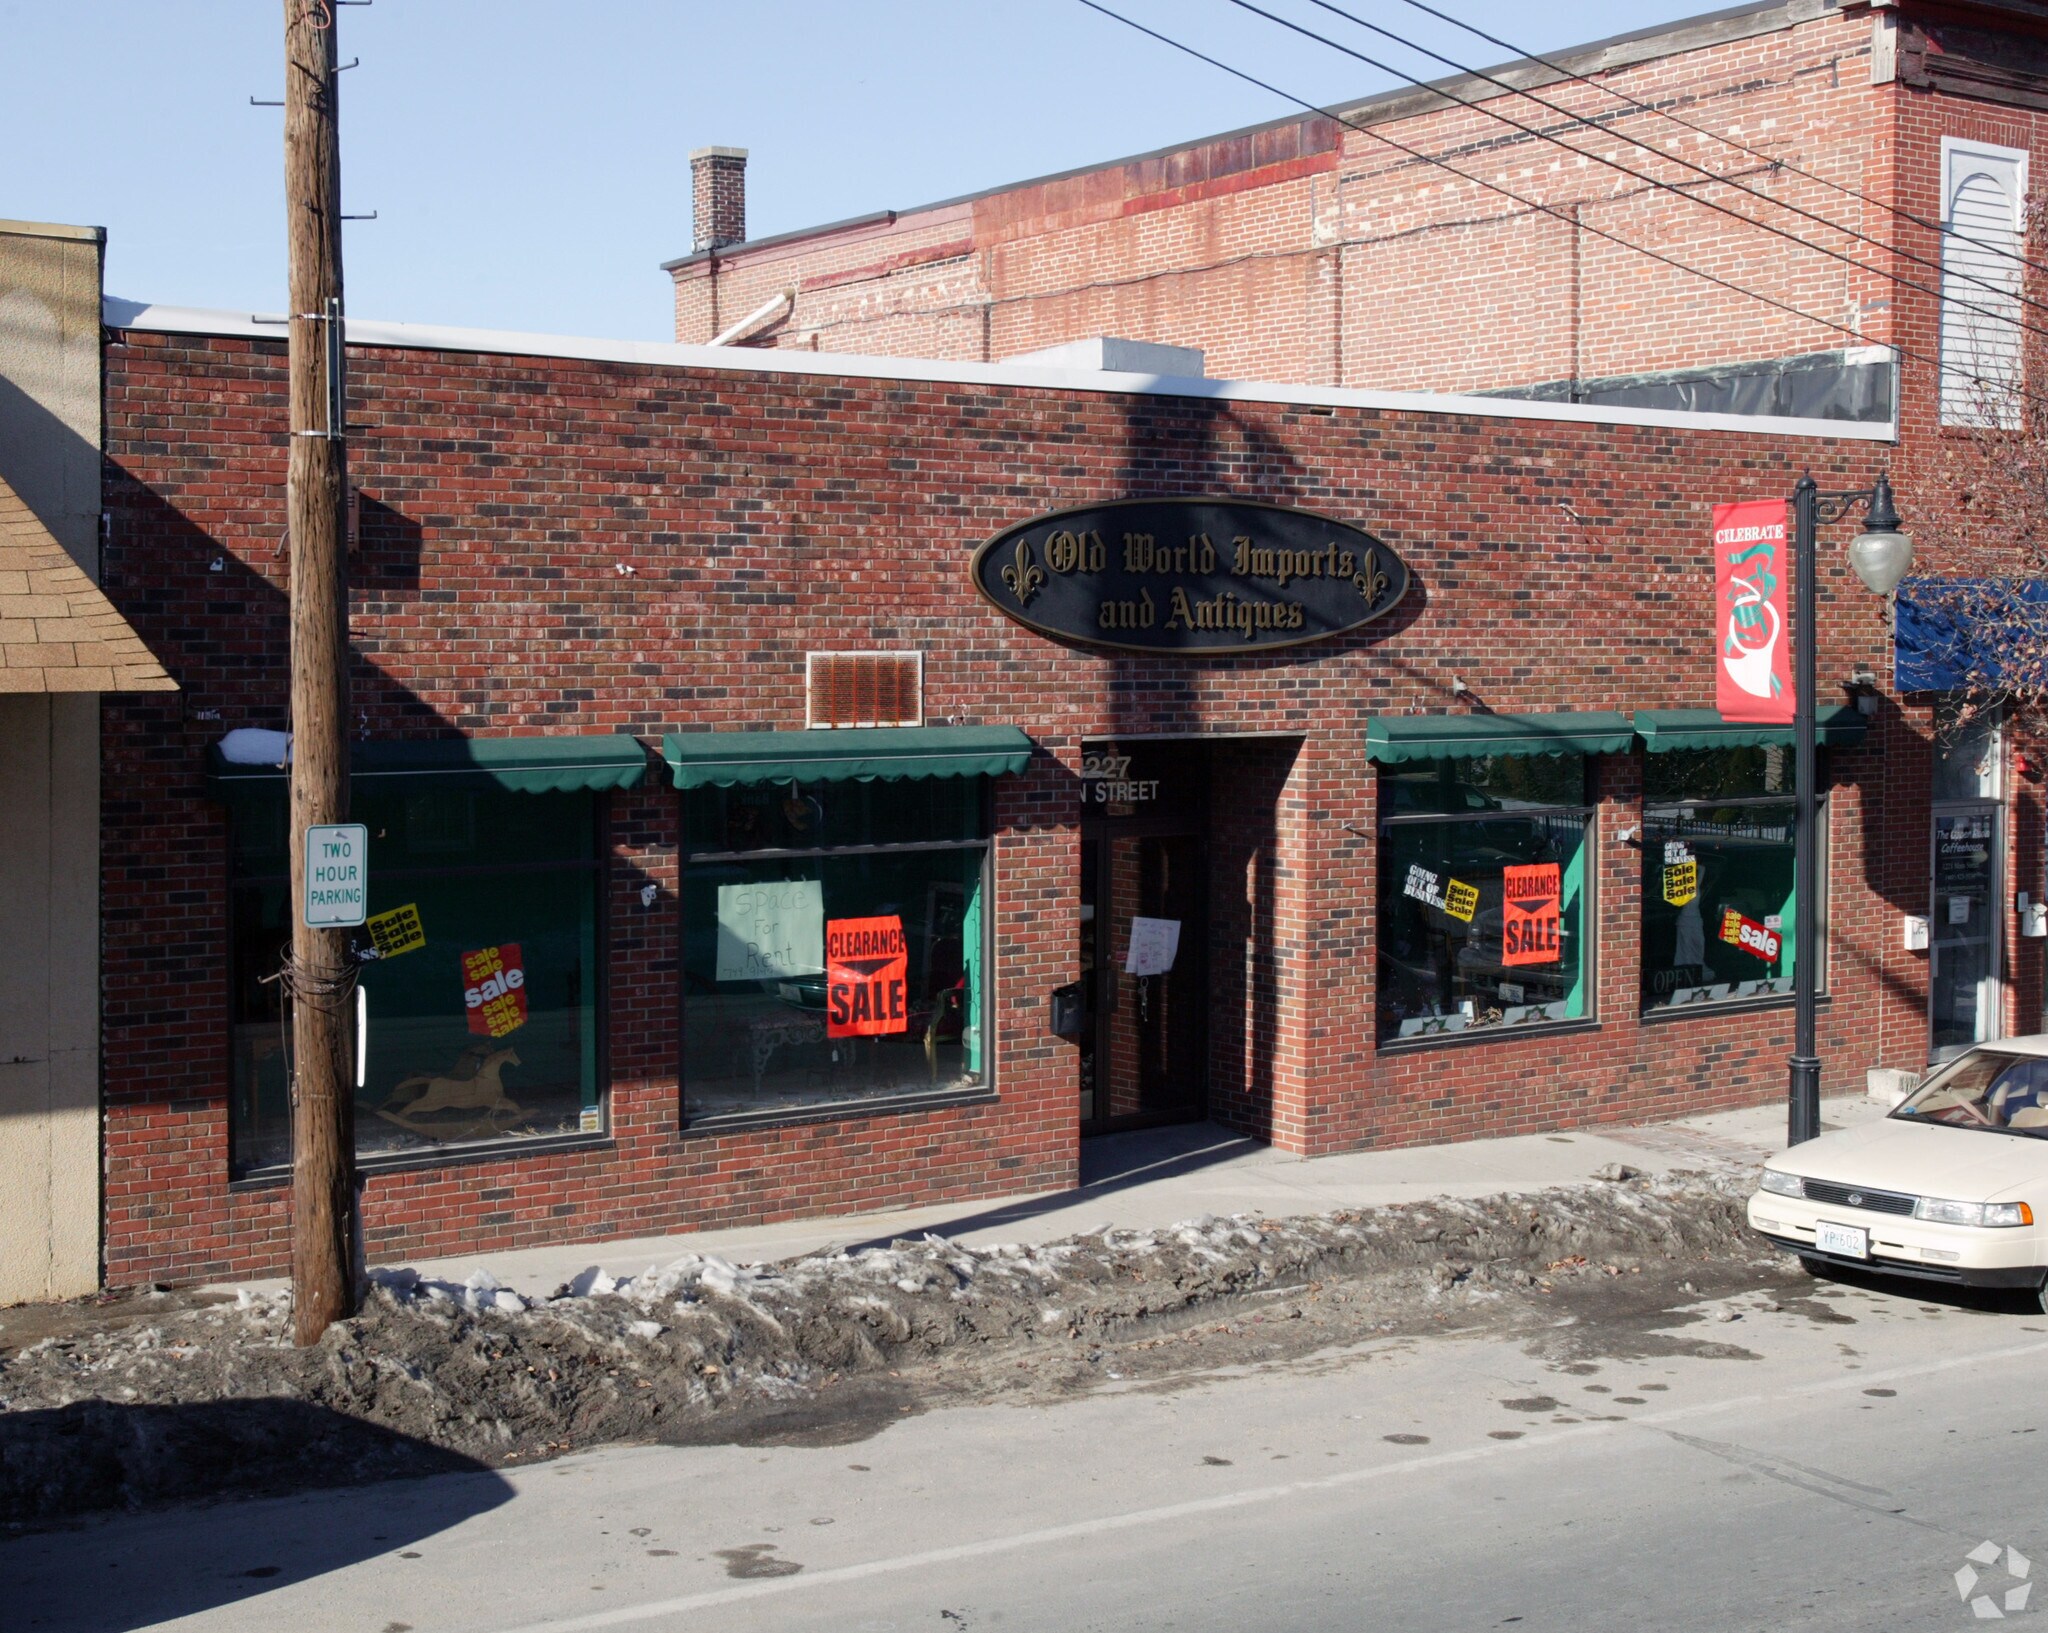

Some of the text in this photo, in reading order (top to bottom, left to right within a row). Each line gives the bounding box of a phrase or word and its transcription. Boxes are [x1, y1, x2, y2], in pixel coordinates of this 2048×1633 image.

[1715, 524, 1784, 544] CELEBRATE
[1043, 530, 1354, 587] Old World Imports
[1100, 585, 1303, 639] and Antiques
[1085, 756, 1131, 778] 227
[1095, 780, 1160, 802] STREET
[323, 842, 351, 858] TWO
[316, 866, 357, 882] HOUR
[1409, 864, 1438, 884] GOING
[1665, 865, 1693, 879] Sale
[1666, 876, 1694, 889] Sale
[1407, 875, 1440, 895] OUT OF
[1450, 885, 1475, 899] Sale
[1506, 875, 1557, 898] CLEARANCE
[1666, 886, 1696, 900] Sale
[311, 888, 361, 905] PARKING
[1403, 883, 1445, 910] BUSINESS
[1448, 893, 1474, 906] Sale
[1446, 902, 1472, 916] Sale
[370, 909, 414, 934] Sale
[374, 920, 418, 945] Sale
[755, 919, 779, 935] For
[378, 930, 422, 956] Sale
[830, 929, 905, 958] CLEARANCE
[1506, 917, 1557, 955] SALE
[1739, 924, 1778, 957] sale
[465, 946, 499, 969] sale
[746, 942, 796, 970] Rent
[470, 959, 503, 981] sale
[464, 968, 524, 1008] sale
[482, 994, 516, 1017] sale
[831, 979, 904, 1026] SALE
[486, 1006, 520, 1030] sale
[490, 1018, 523, 1038] sale
